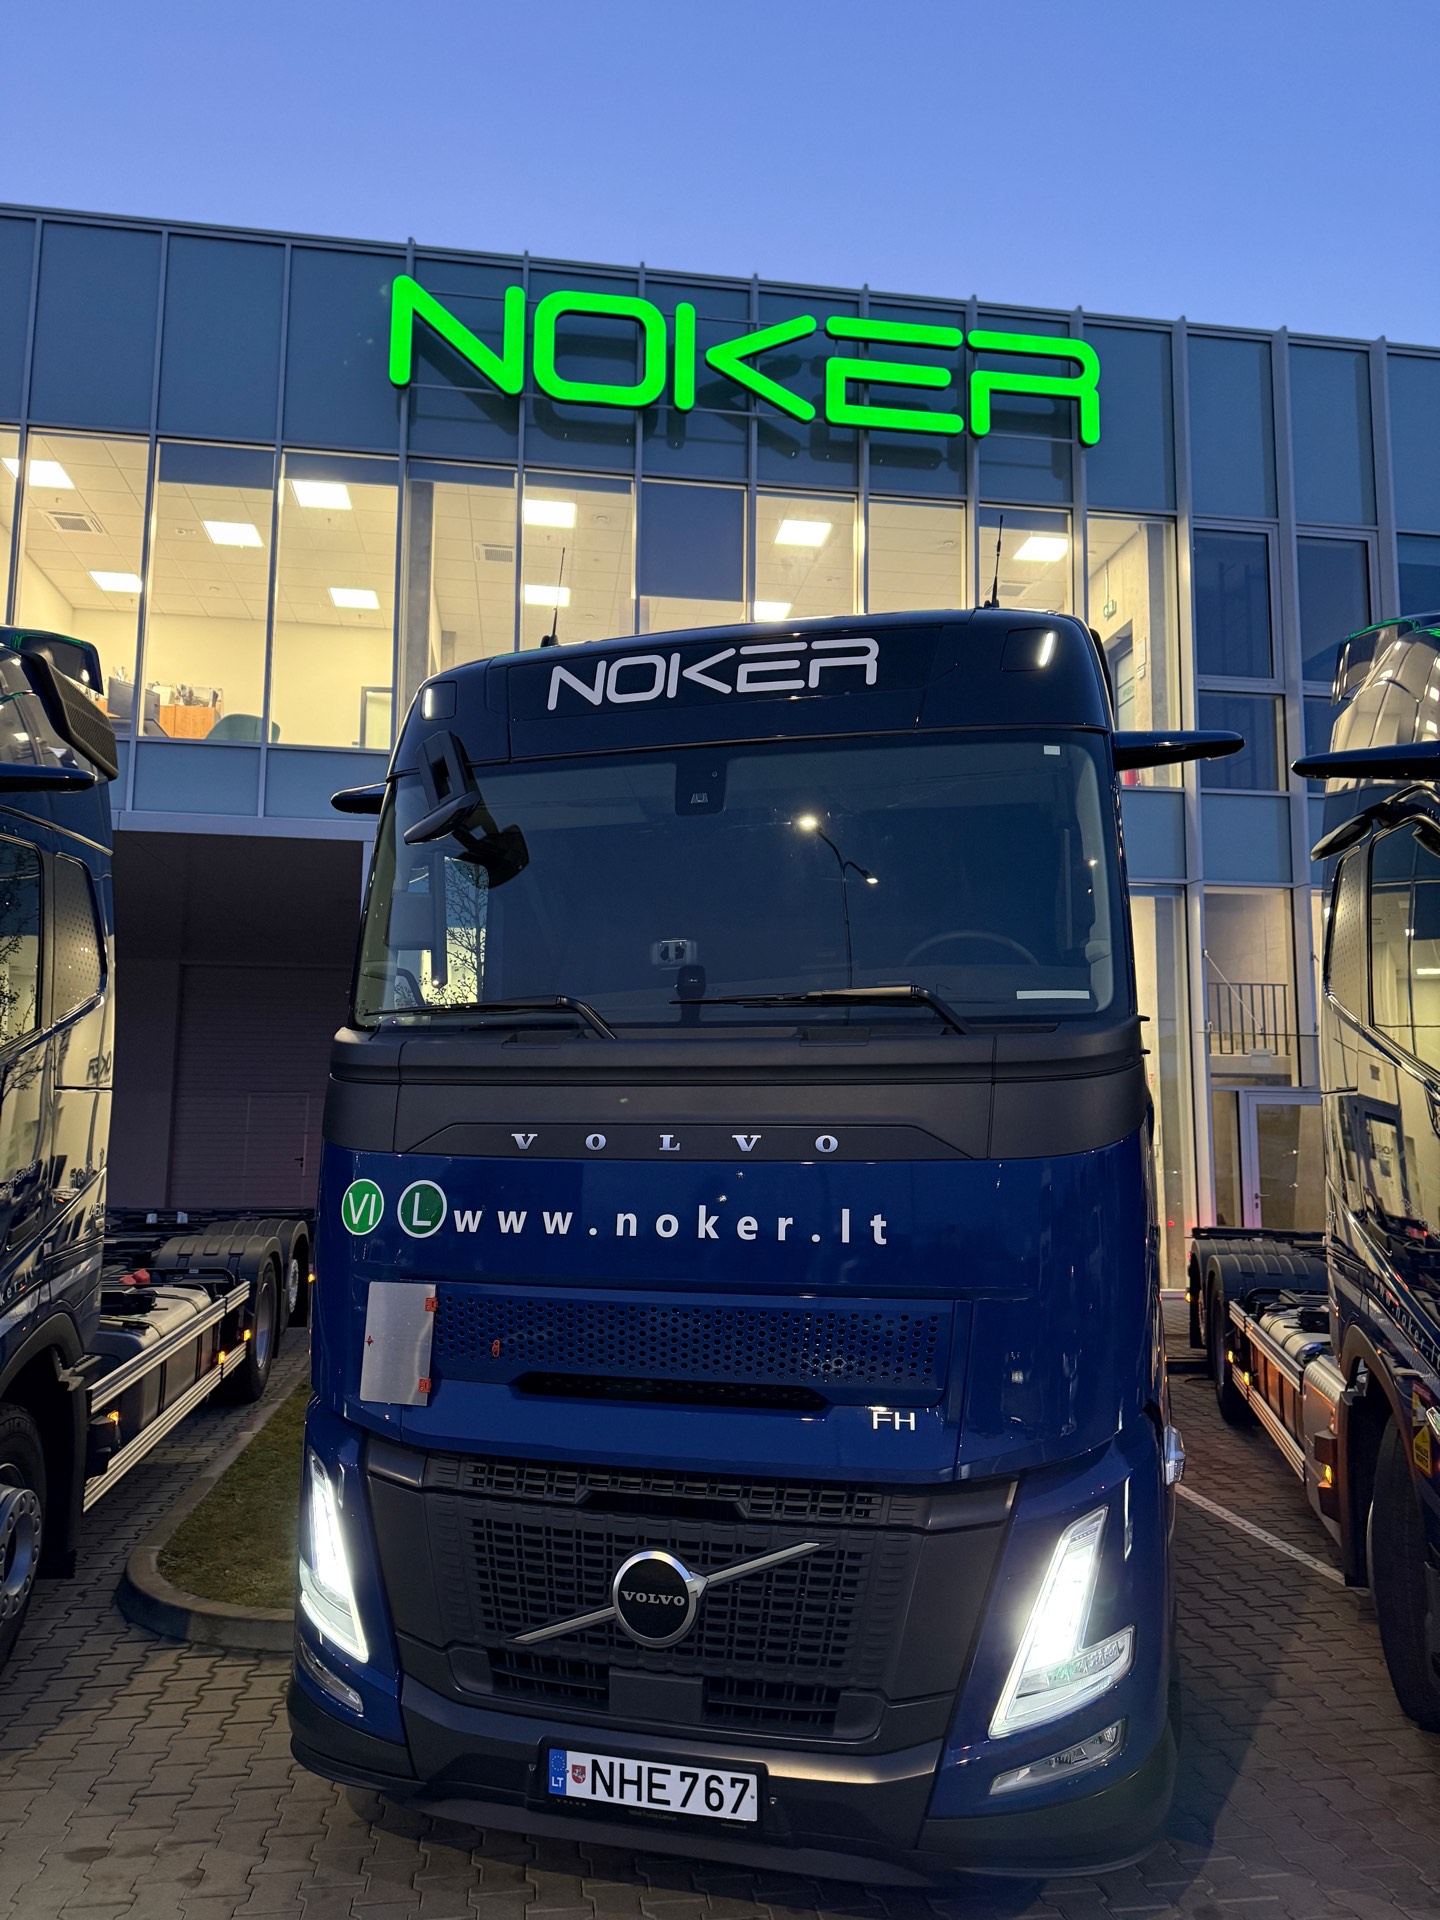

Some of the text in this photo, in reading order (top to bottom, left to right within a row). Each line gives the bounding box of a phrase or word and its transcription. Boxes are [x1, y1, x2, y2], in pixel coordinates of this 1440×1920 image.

[388, 274, 1101, 446] NOKER
[547, 637, 880, 711] NOKER
[510, 1133, 839, 1153] VOLVO
[348, 1192, 377, 1226] VI
[412, 1192, 432, 1226] L
[453, 1204, 888, 1246] www.noker.lt
[872, 1411, 916, 1431] FH
[621, 1590, 686, 1607] VOLVO
[551, 1776, 565, 1788] LT
[590, 1758, 751, 1815] NHE767
